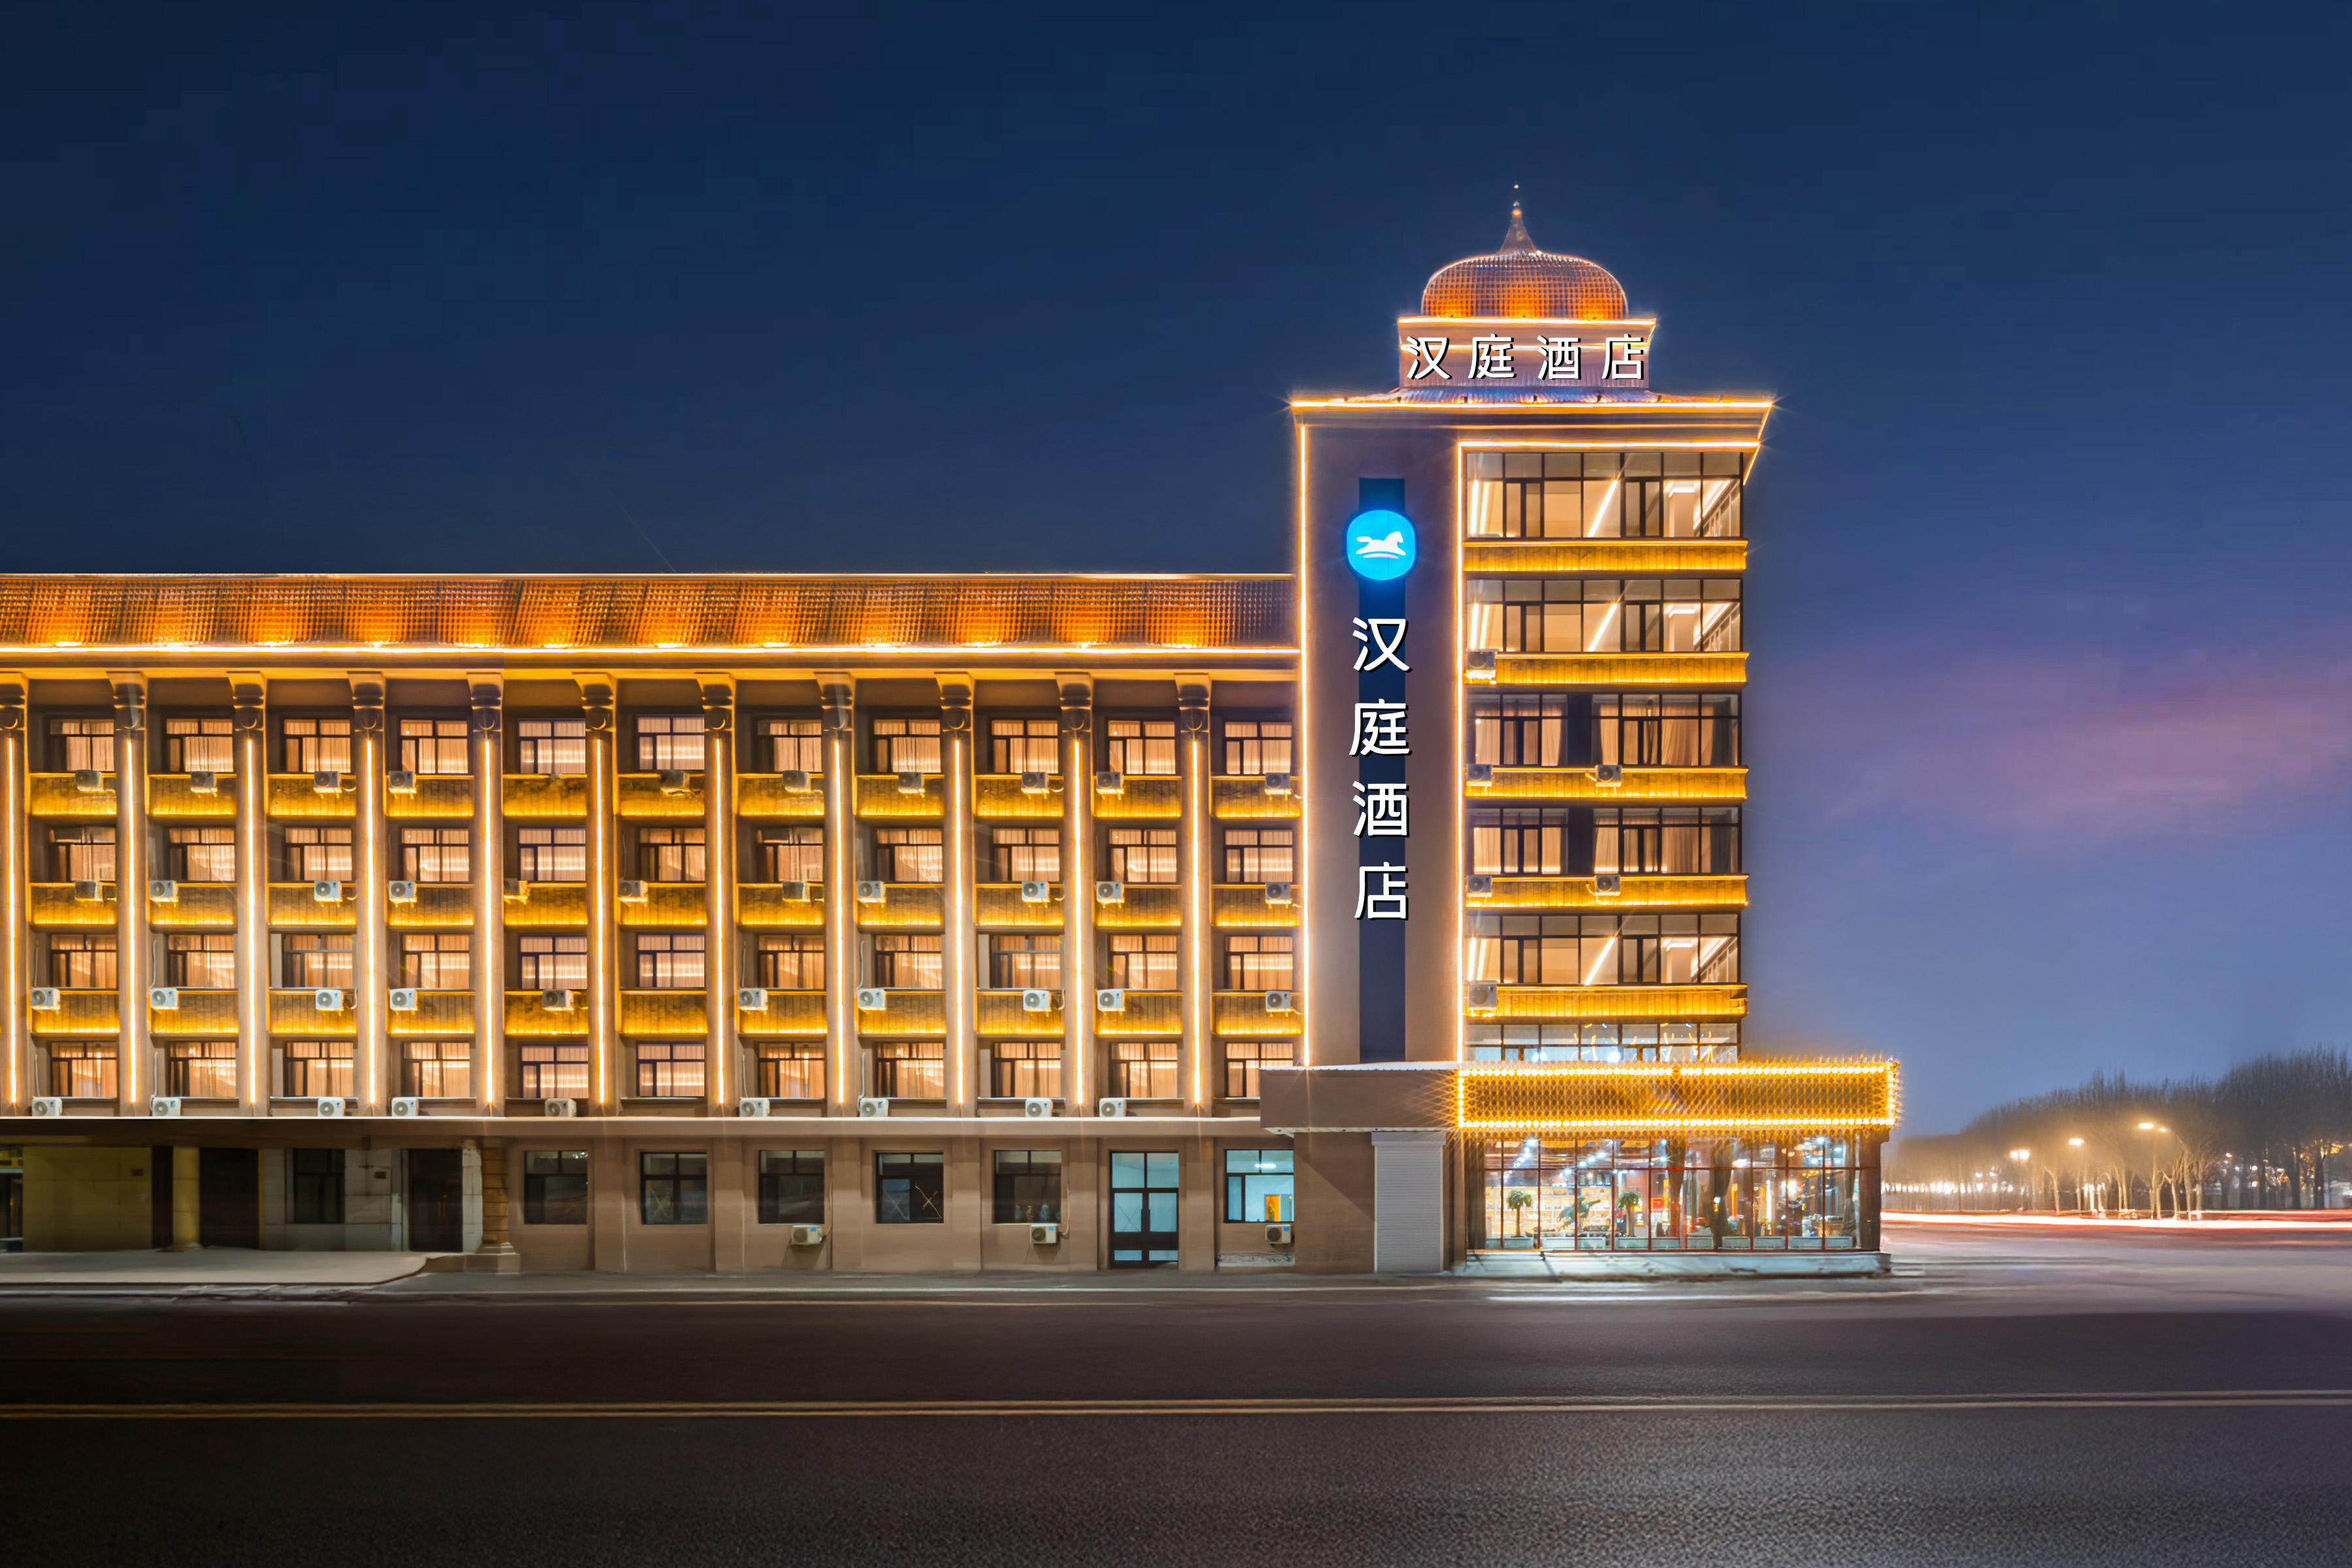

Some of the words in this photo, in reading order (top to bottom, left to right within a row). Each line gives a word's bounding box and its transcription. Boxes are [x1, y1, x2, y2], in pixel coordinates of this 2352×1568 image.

[1406, 334, 1643, 379] 汉庭酒店
[1350, 617, 1410, 919] 汉庭酒店
